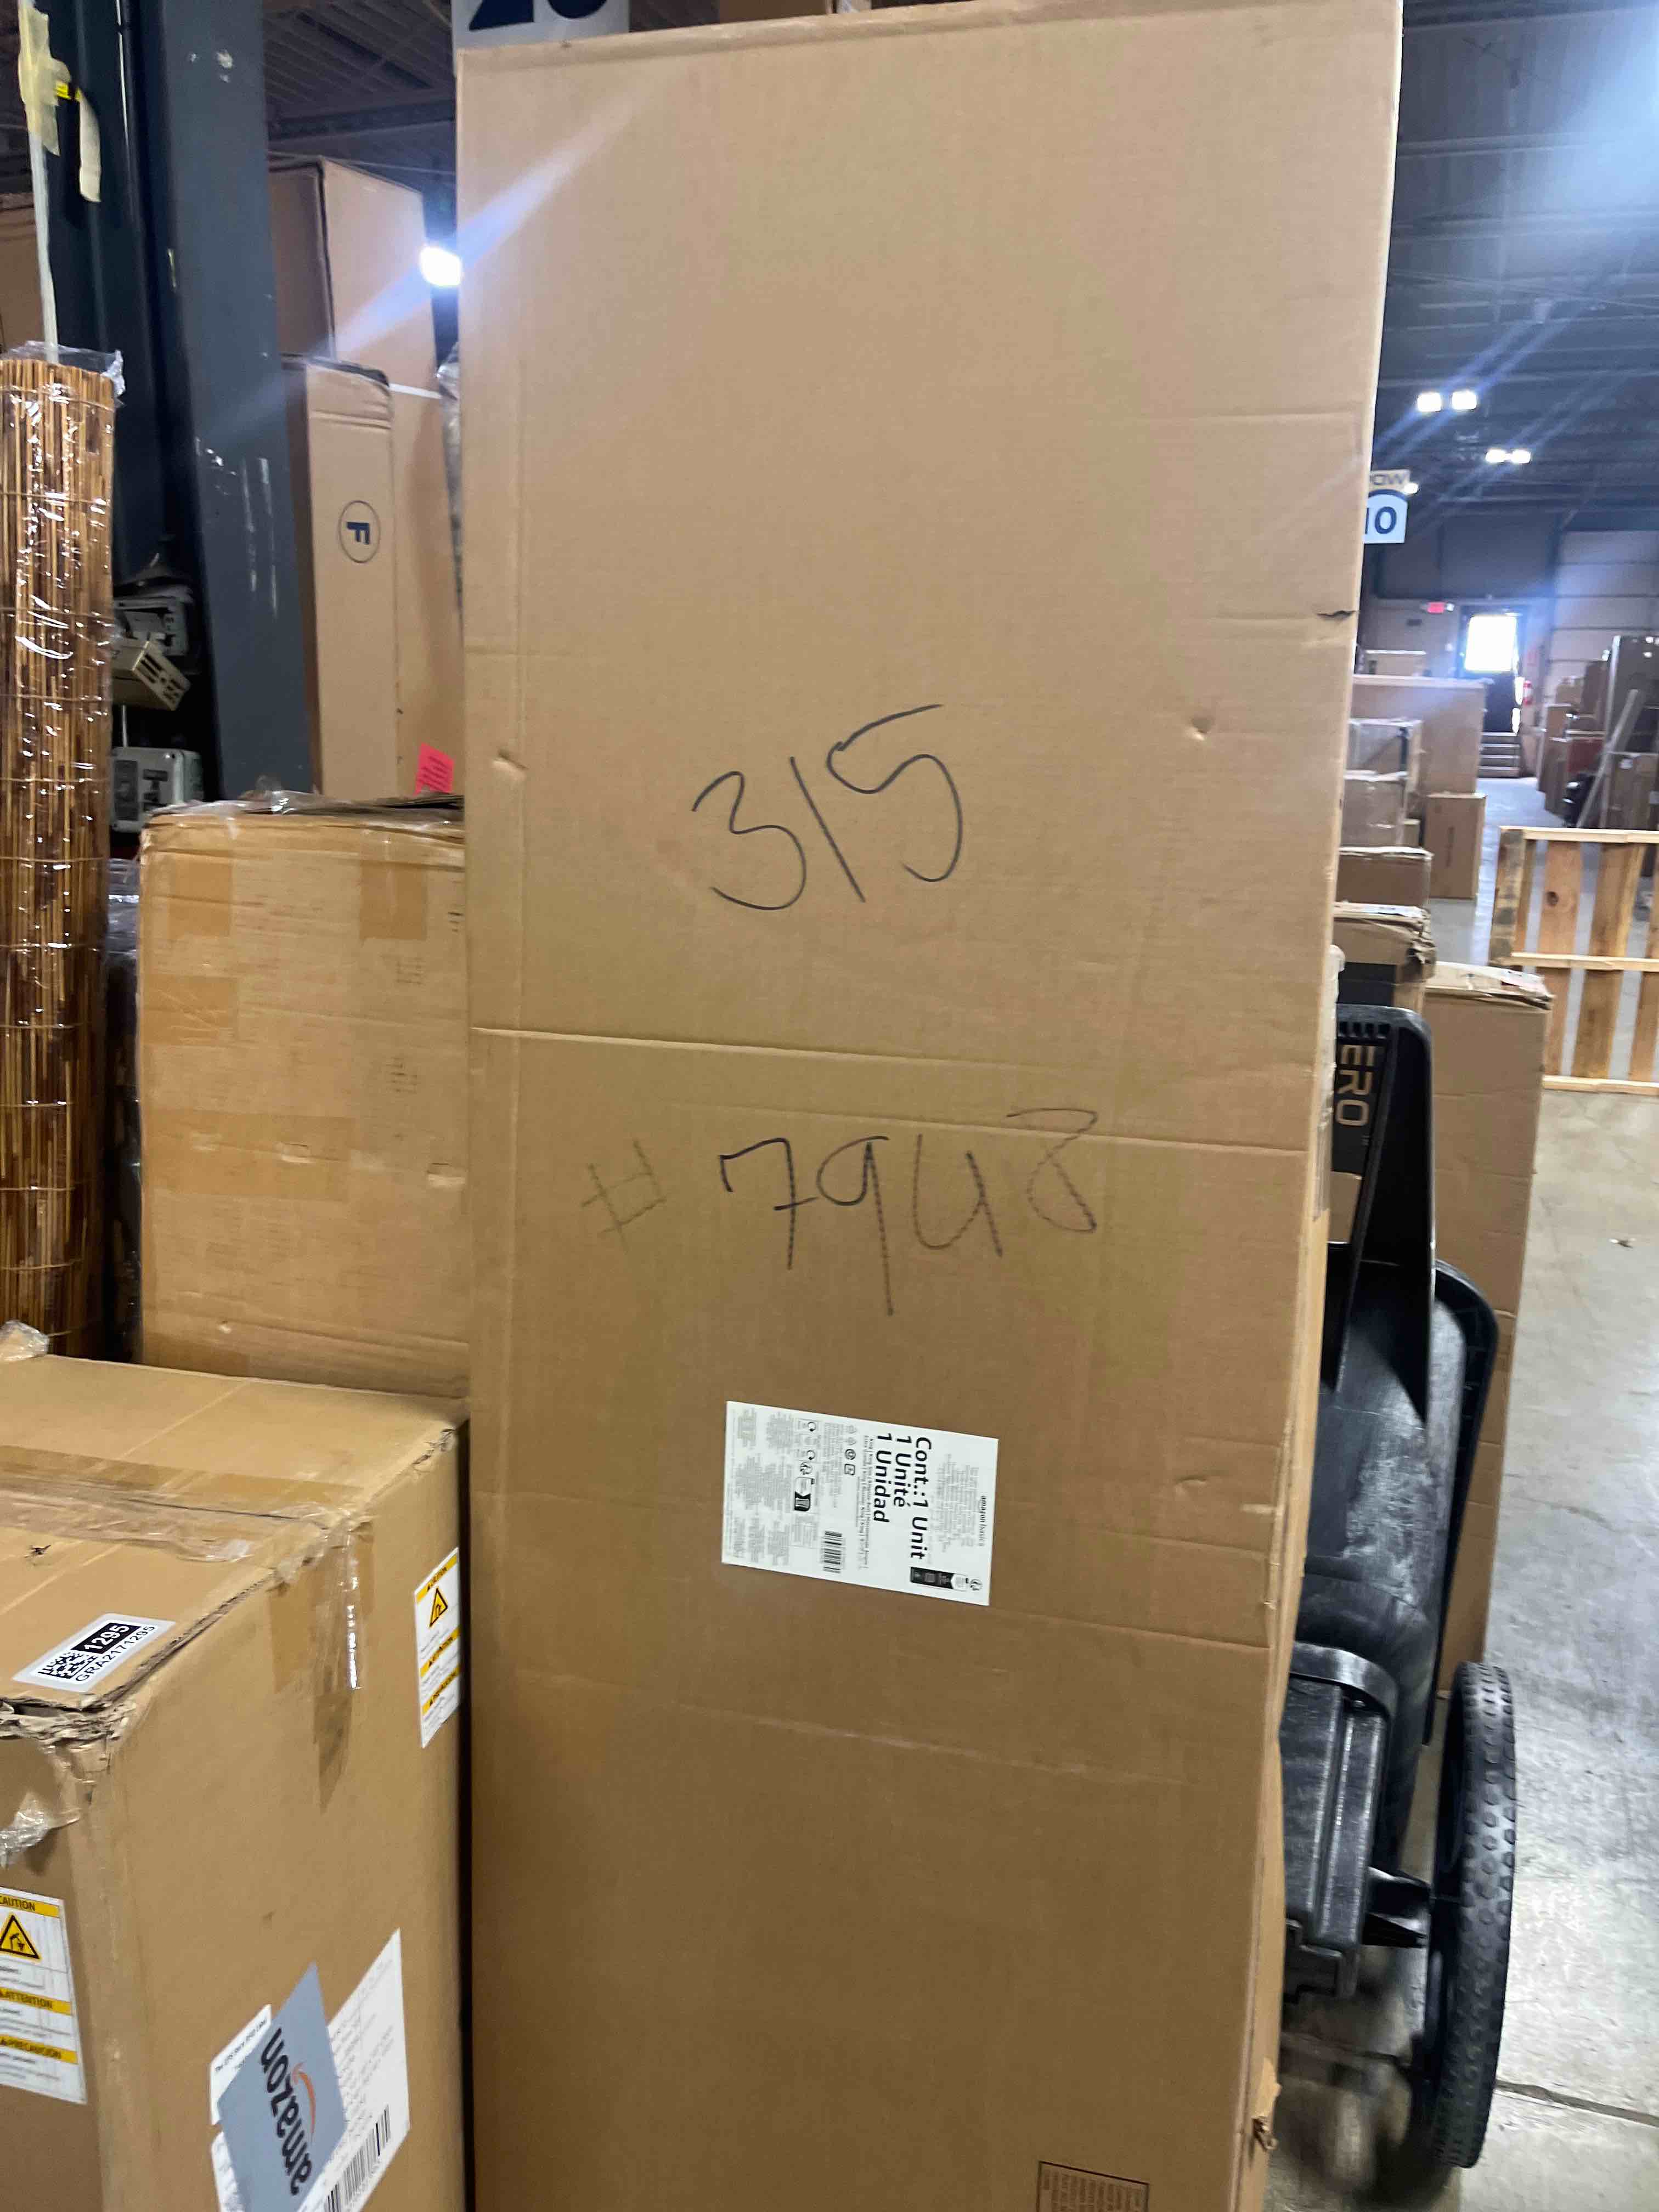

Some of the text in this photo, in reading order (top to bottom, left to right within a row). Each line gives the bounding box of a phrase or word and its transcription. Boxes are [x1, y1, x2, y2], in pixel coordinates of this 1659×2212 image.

[1369, 474, 1406, 486] OW
[346, 522, 371, 545] F
[691, 704, 963, 911] 315
[719, 1108, 1097, 1317] 7948
[873, 1450, 891, 1523] Unidad
[893, 1453, 911, 1507] Unité
[910, 1516, 928, 1559] Unit
[75, 1626, 155, 1681] GRA2171295
[83, 1624, 131, 1650] 1295
[260, 2028, 312, 2196] amazon
